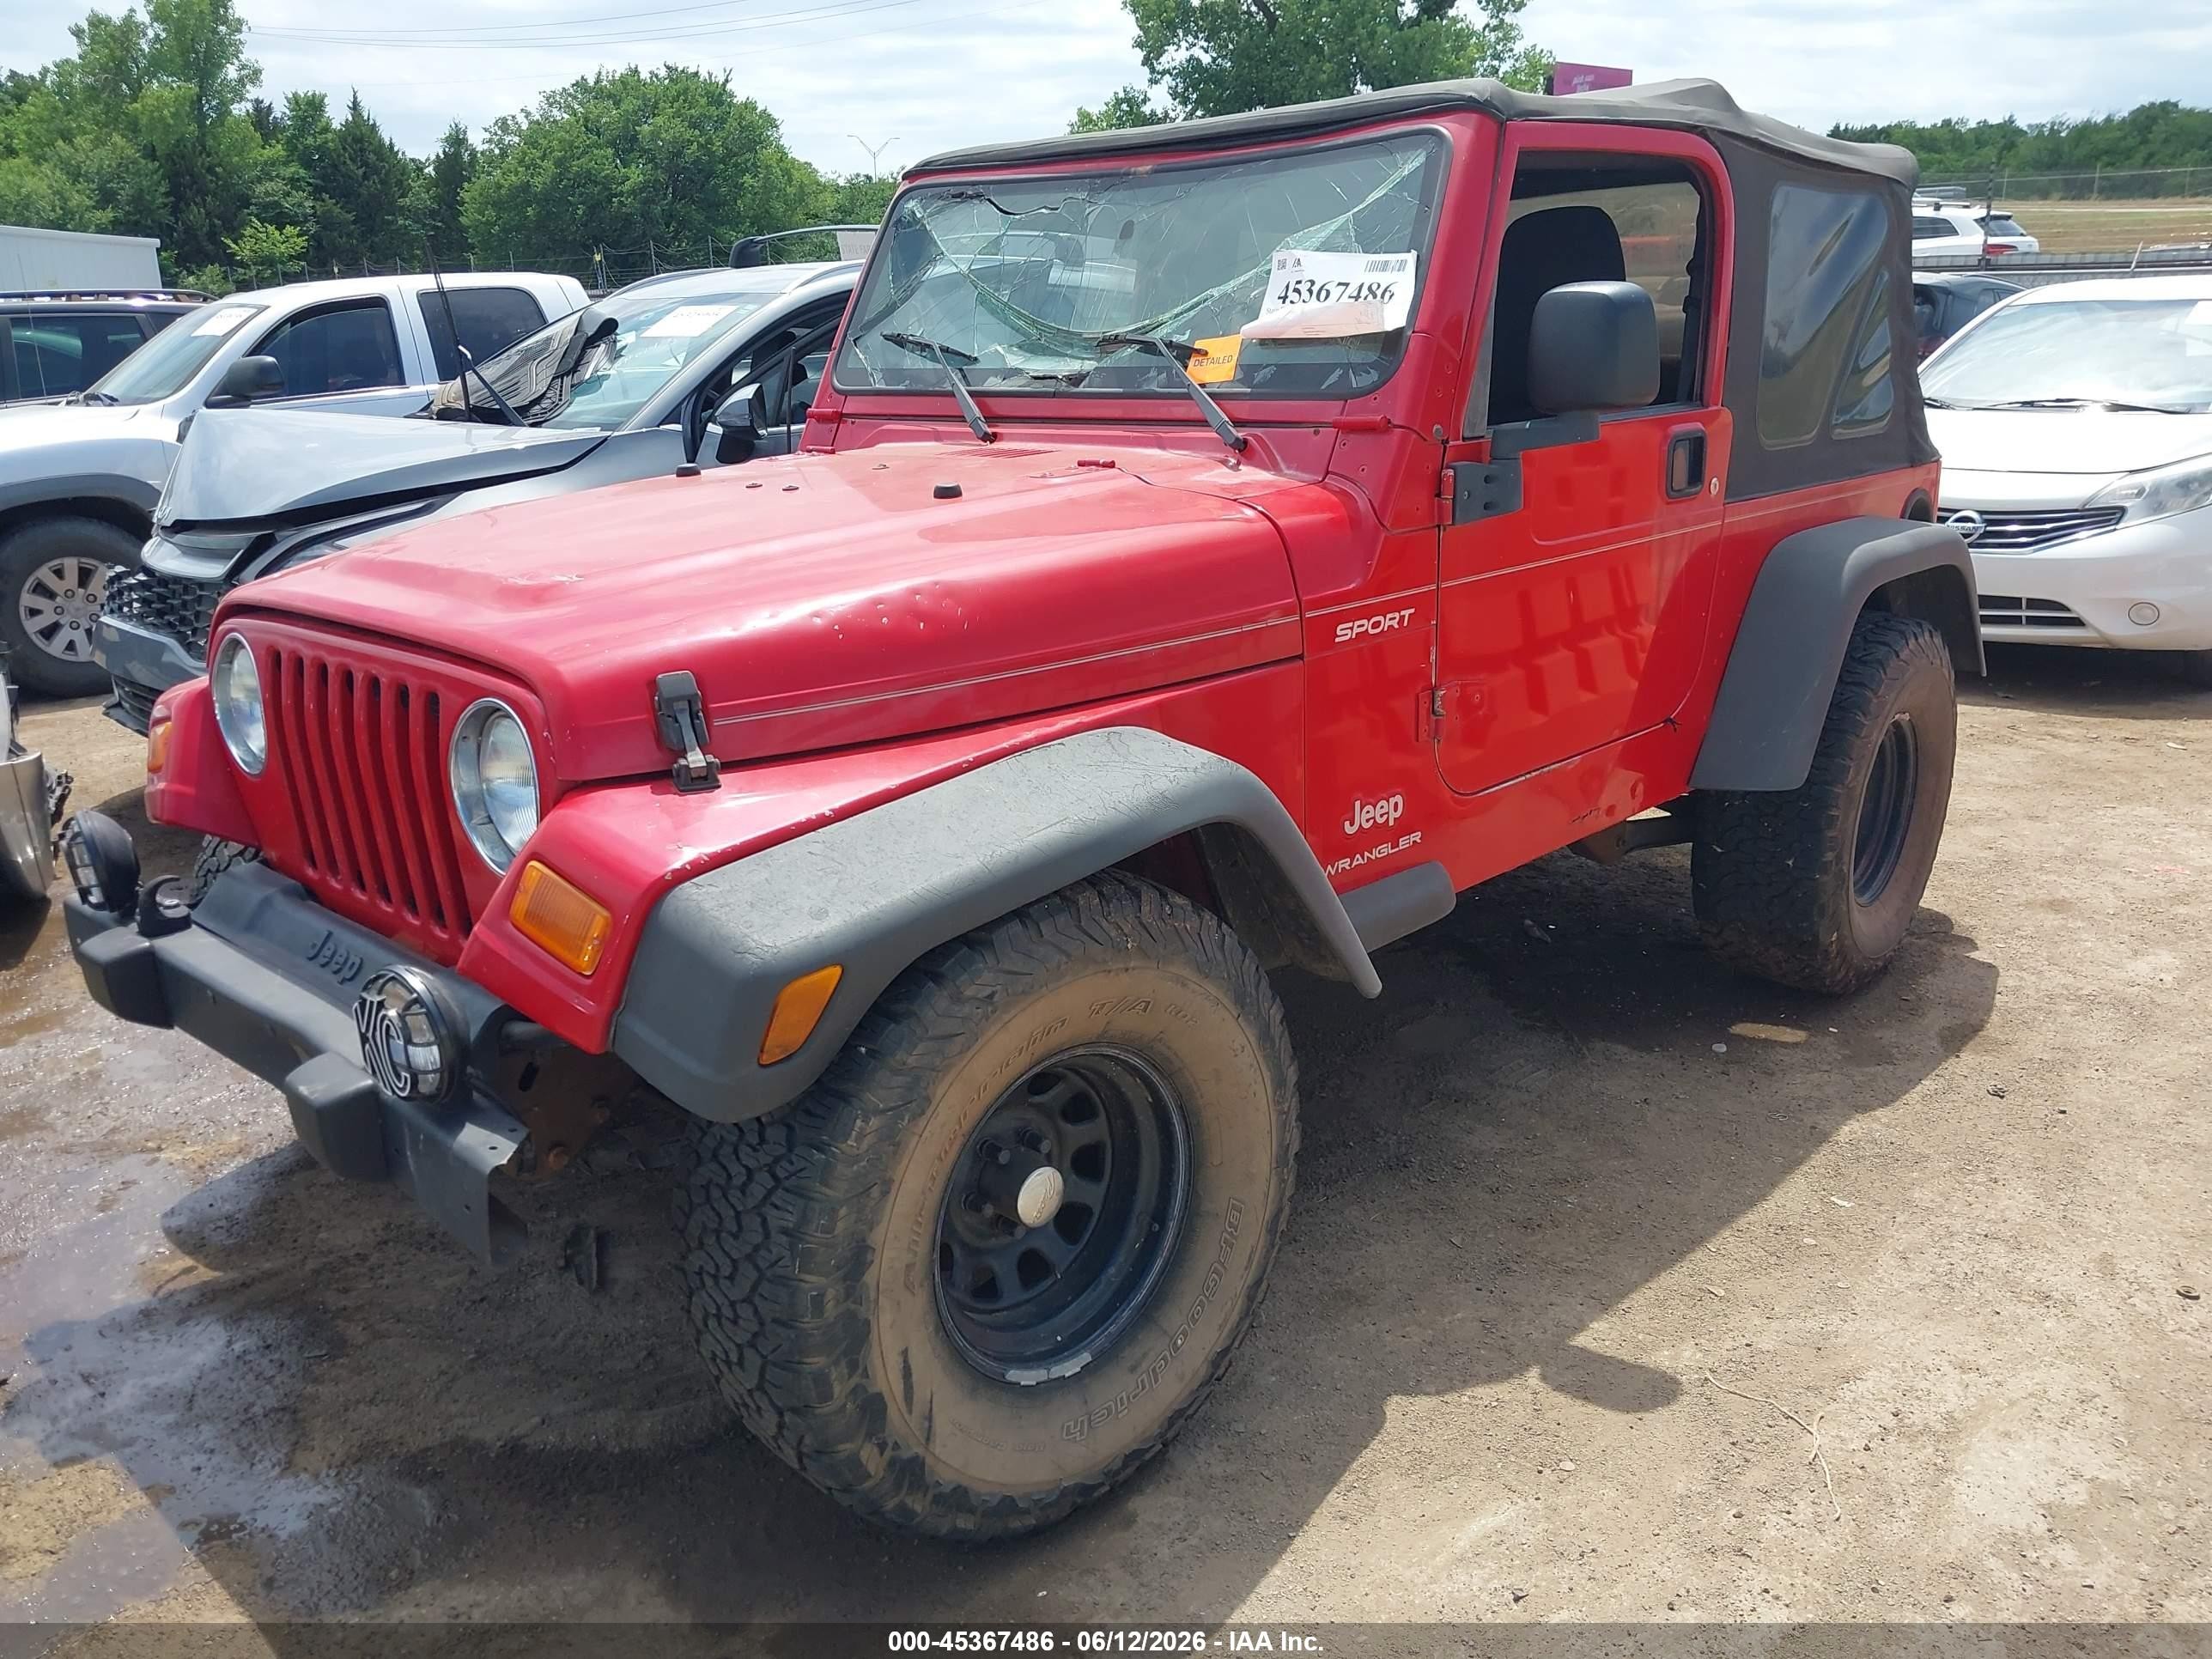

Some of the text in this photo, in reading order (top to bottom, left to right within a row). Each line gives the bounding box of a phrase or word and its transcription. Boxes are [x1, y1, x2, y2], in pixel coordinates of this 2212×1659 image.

[1277, 279, 1399, 305] 45367486
[1193, 355, 1233, 368] DETAILED
[1334, 608, 1415, 643] SPORT
[1344, 793, 1404, 836] Jeep
[1325, 831, 1422, 876] WRANGLER
[307, 930, 364, 985] Jeep
[1089, 996, 1153, 1019] T/A
[1062, 1197, 1244, 1443] BFGoodrich
